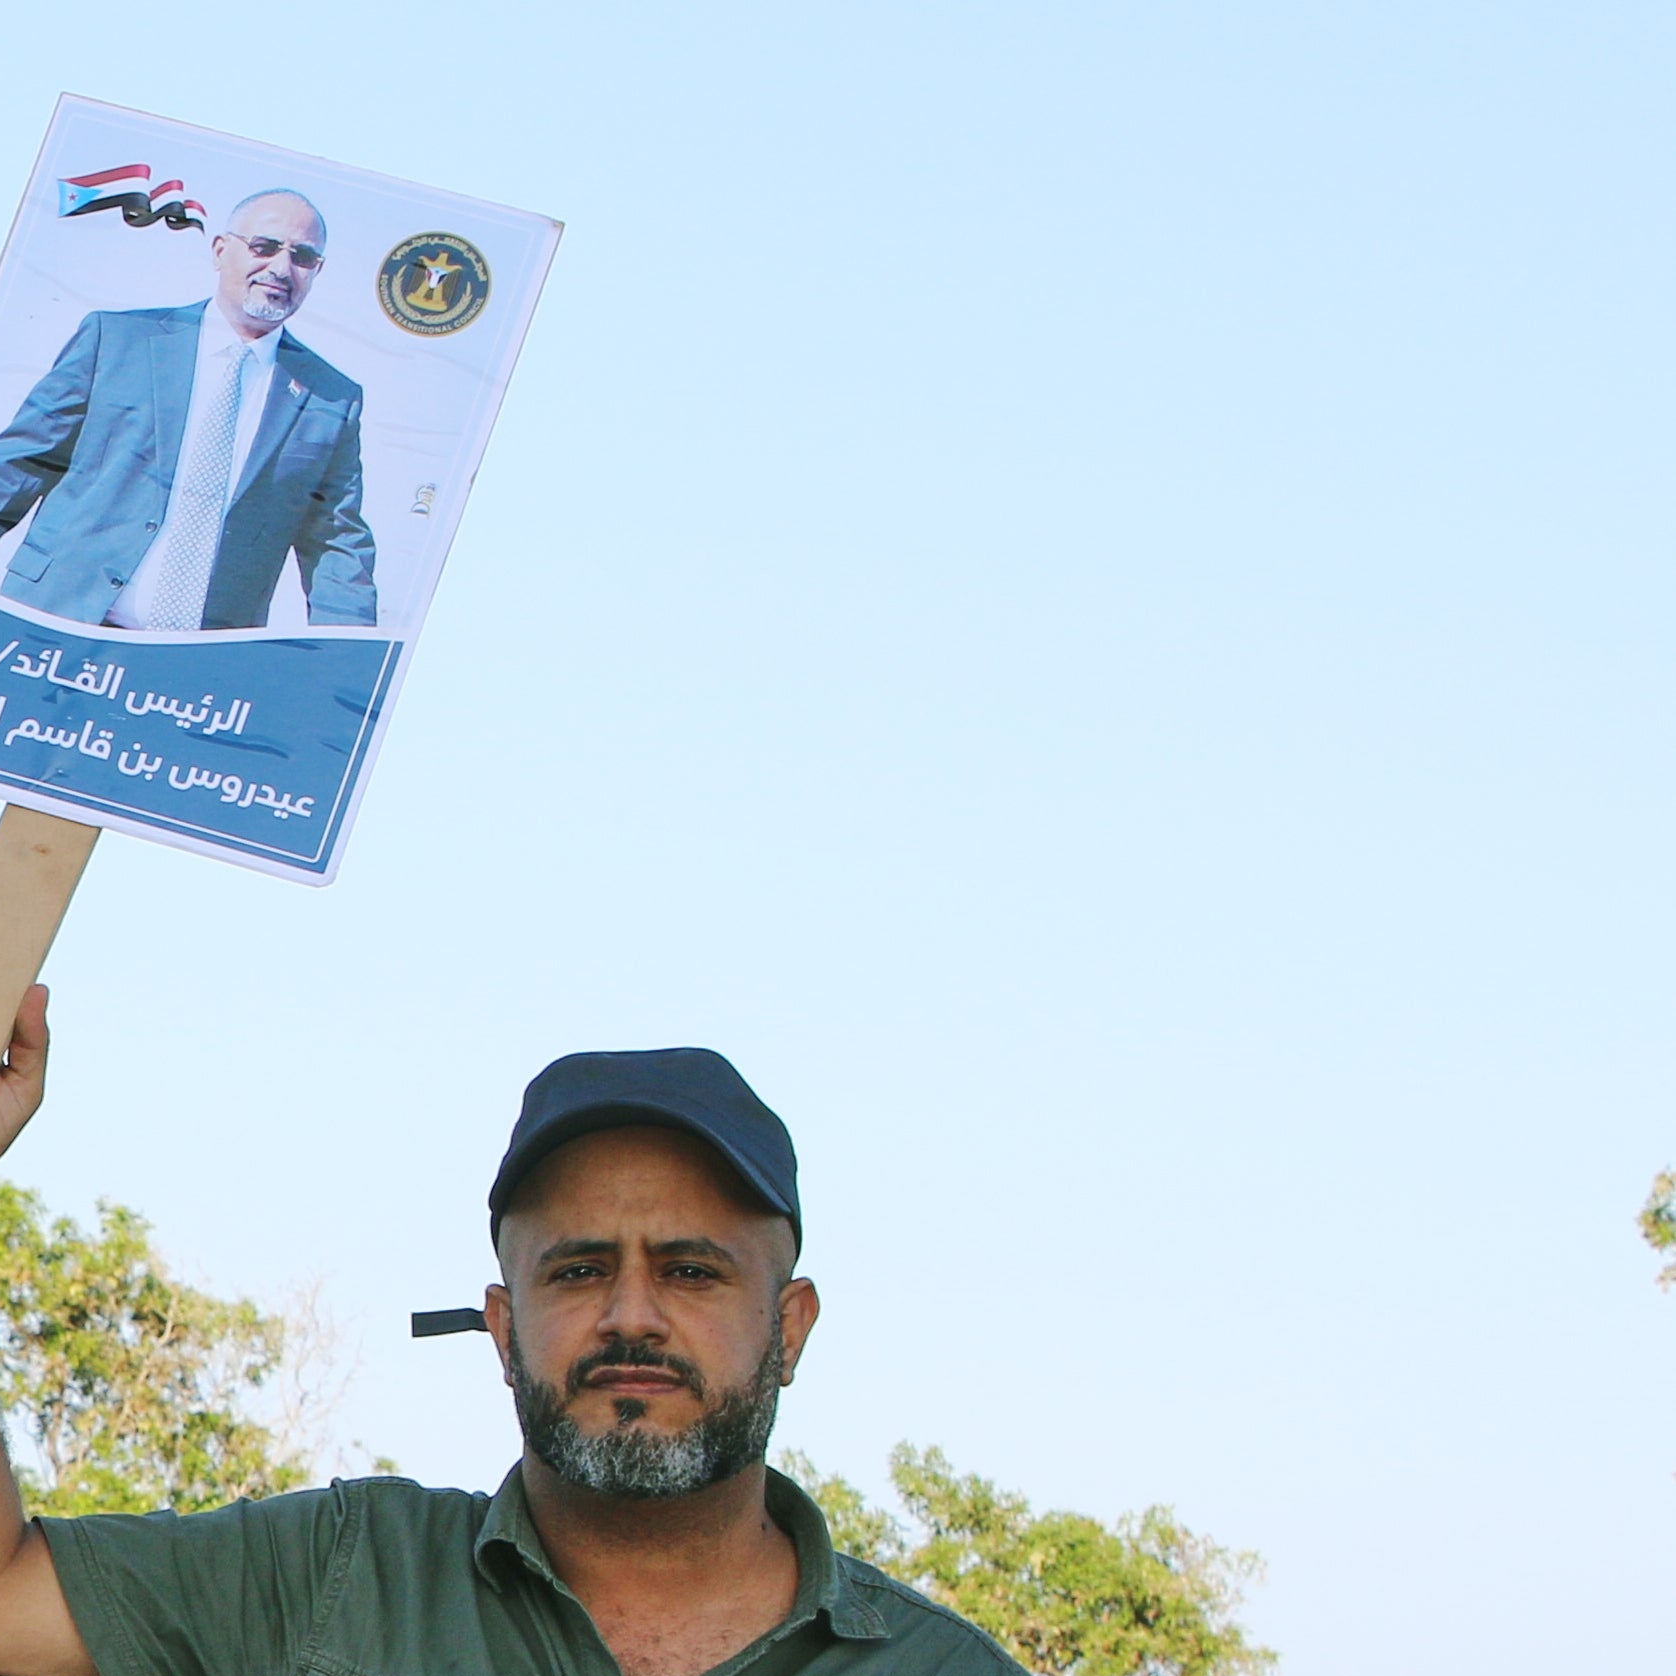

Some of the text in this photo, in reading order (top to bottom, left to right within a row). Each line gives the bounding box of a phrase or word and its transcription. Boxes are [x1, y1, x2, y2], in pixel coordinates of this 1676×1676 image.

[394, 313, 453, 334] TRANSITIONAL
[454, 298, 484, 328] COUNCIL
[125, 689, 251, 736] الرئيس
[4, 719, 114, 761] قاسم
[116, 743, 163, 783] بن
[168, 763, 317, 819] عيدروس
